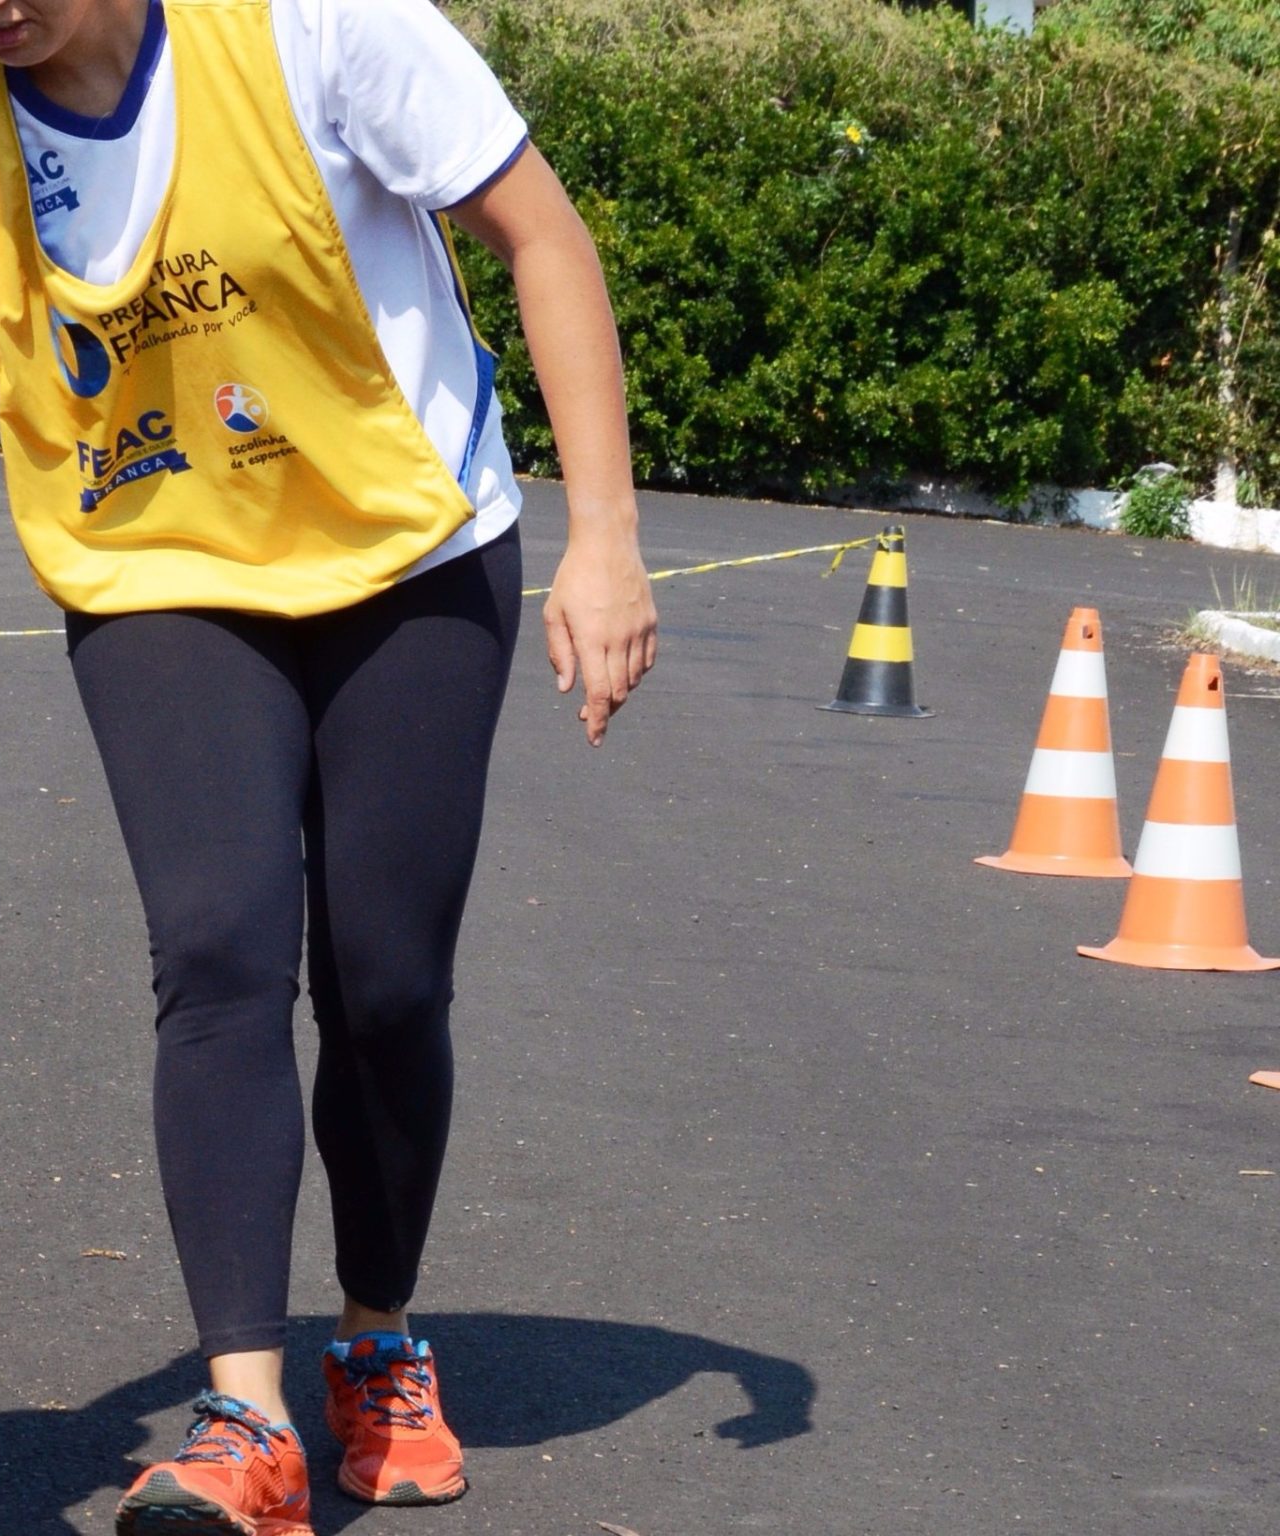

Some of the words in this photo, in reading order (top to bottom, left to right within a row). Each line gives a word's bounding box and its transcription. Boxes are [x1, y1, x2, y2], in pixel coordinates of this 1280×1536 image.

[26, 150, 65, 185] AC
[203, 321, 223, 337] por
[76, 410, 172, 478] FEAC
[228, 434, 288, 455] escolinha
[231, 459, 244, 470] de
[248, 446, 298, 465] esportes
[93, 457, 166, 501] FRANCA
